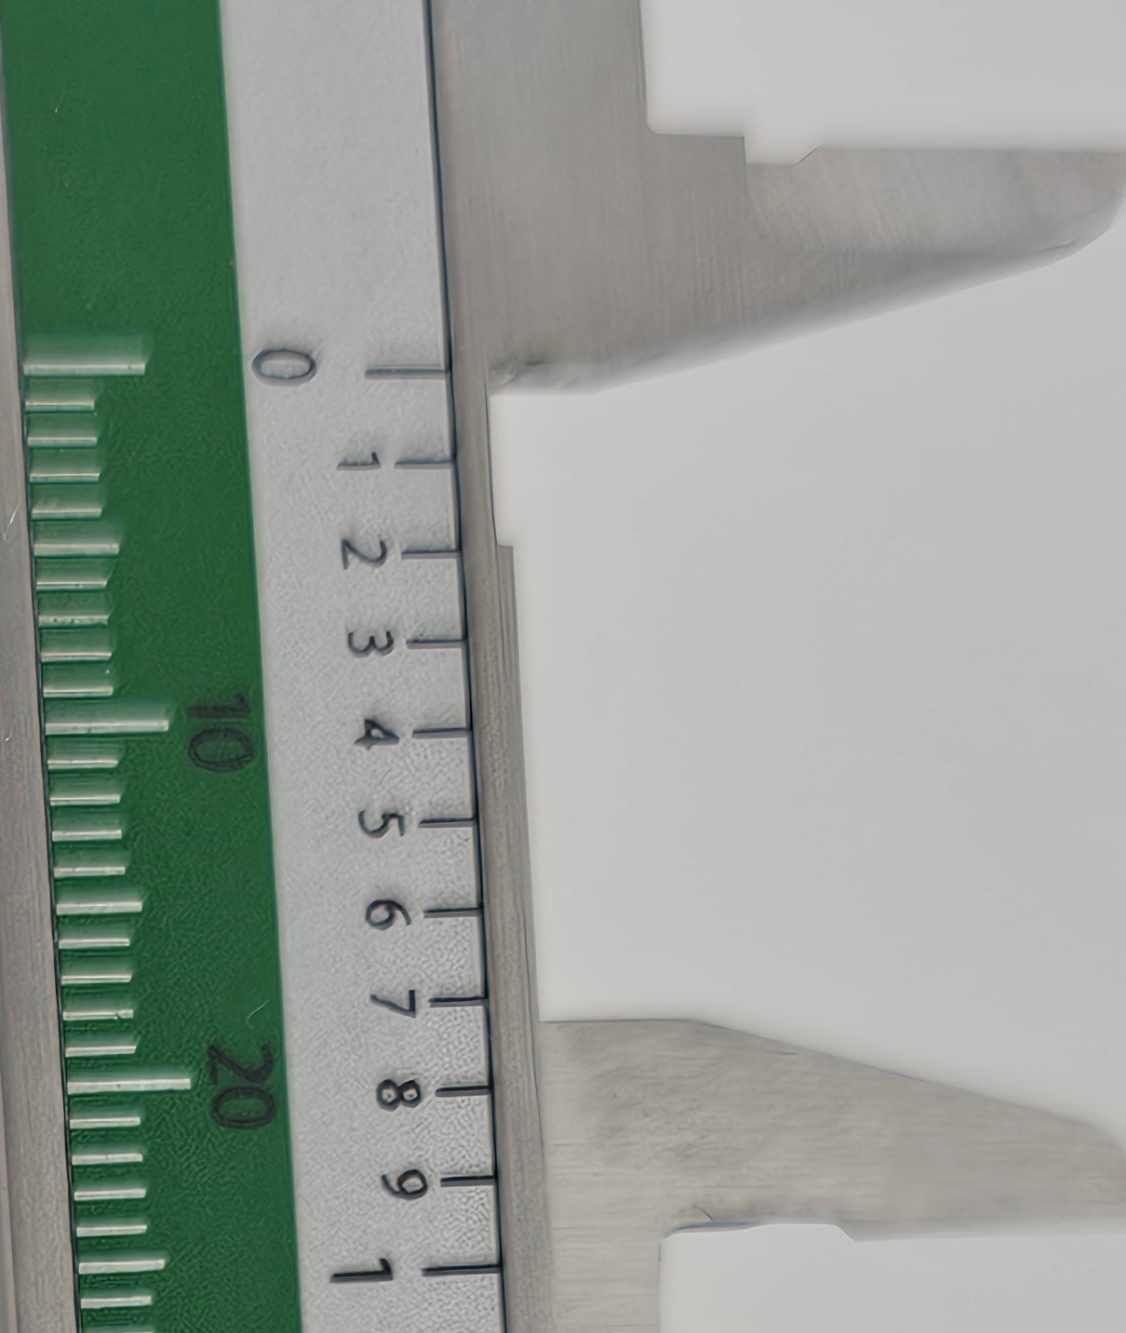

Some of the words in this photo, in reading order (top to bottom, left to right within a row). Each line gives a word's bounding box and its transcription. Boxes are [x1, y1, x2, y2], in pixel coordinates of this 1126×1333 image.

[252, 348, 317, 384] 0
[337, 452, 381, 471] 1
[340, 538, 388, 570] 2
[347, 630, 395, 657] 3
[186, 693, 255, 772] 10
[354, 717, 399, 750] 4
[358, 808, 406, 839] 5
[364, 899, 411, 931] 6
[370, 989, 417, 1018] 7
[207, 1042, 277, 1130] 20
[376, 1079, 422, 1111] 8
[381, 1168, 428, 1201] 9
[330, 1258, 394, 1283] 1
